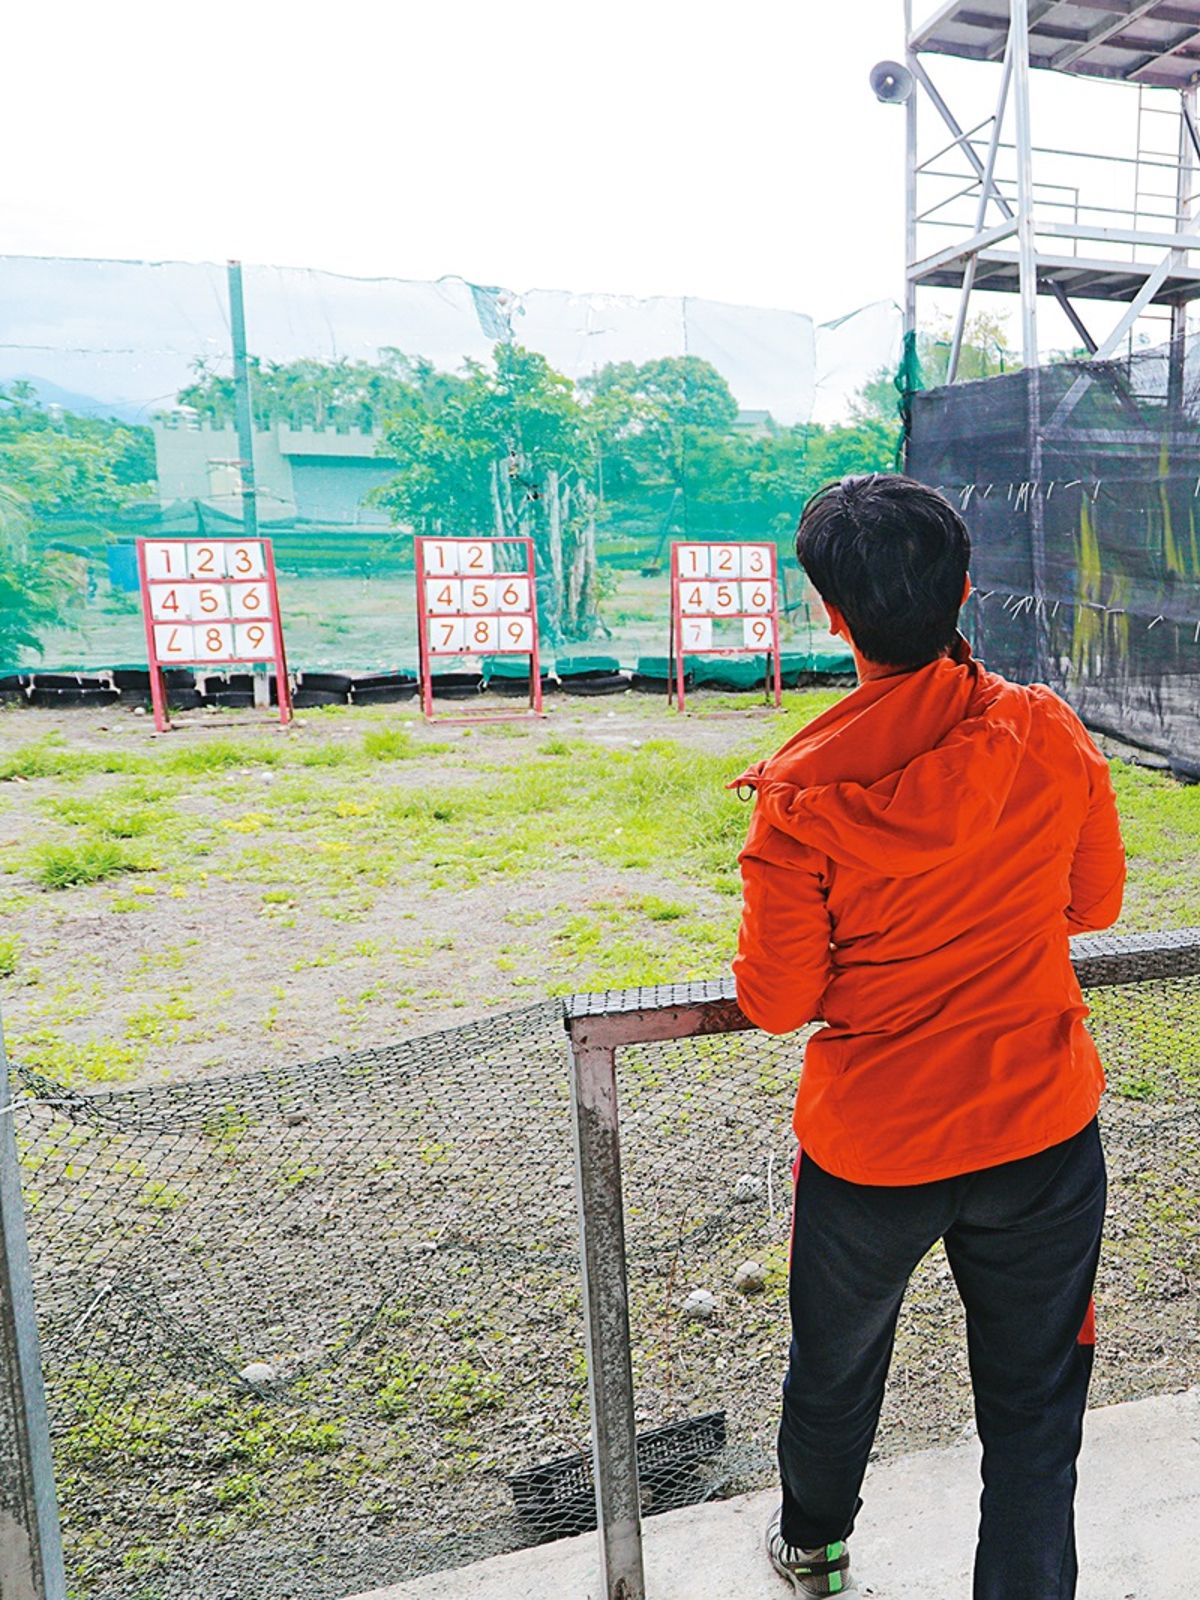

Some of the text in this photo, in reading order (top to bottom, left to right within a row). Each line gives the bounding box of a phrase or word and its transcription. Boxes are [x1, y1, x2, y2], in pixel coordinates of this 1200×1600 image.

[160, 548, 252, 573] 1 2 3
[435, 546, 484, 568] 1 2
[689, 549, 764, 572] 1 2 3
[161, 587, 260, 613] 4 5 6
[437, 583, 519, 607] 4 5 6
[688, 586, 766, 607] 4 5 6
[206, 627, 223, 652] 8
[247, 625, 265, 649] 9
[440, 621, 524, 646] 7 8 9
[689, 621, 766, 642] 7 9
